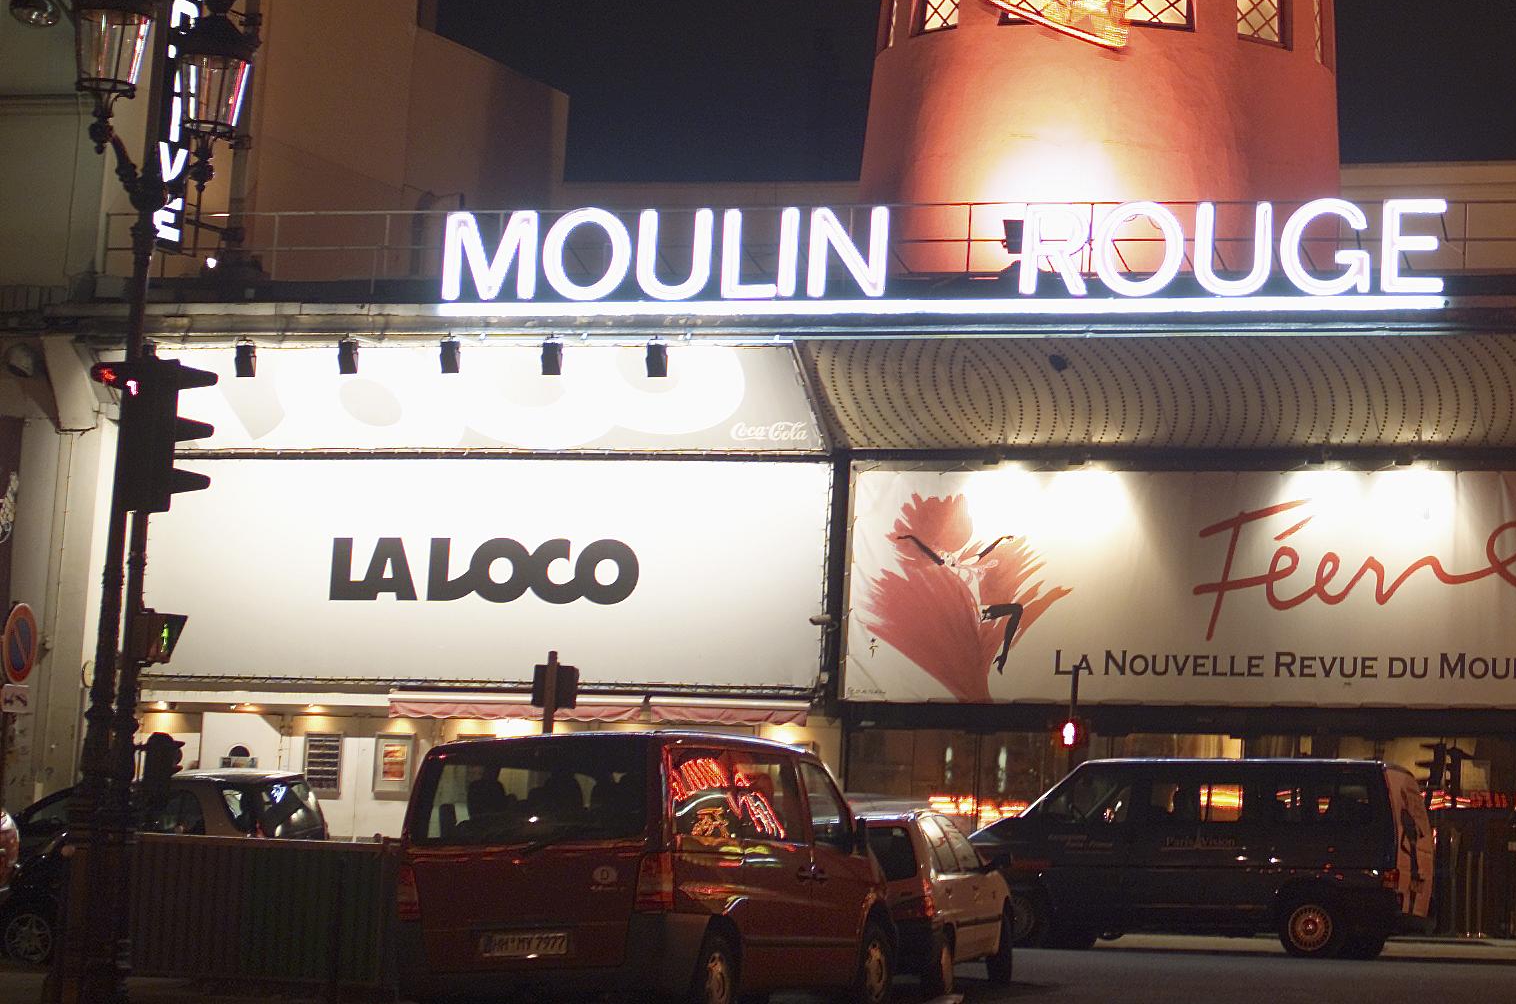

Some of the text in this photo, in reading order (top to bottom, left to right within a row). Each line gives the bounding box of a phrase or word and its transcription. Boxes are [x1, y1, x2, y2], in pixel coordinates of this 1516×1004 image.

[444, 198, 1447, 301] MOULIN ROUGE
[730, 421, 809, 441] Coca-Cola
[328, 536, 640, 606] LA LOCO
[1103, 649, 1265, 678] NOUVELLE
[1274, 651, 1379, 679] REVUE
[1387, 656, 1430, 680] DU
